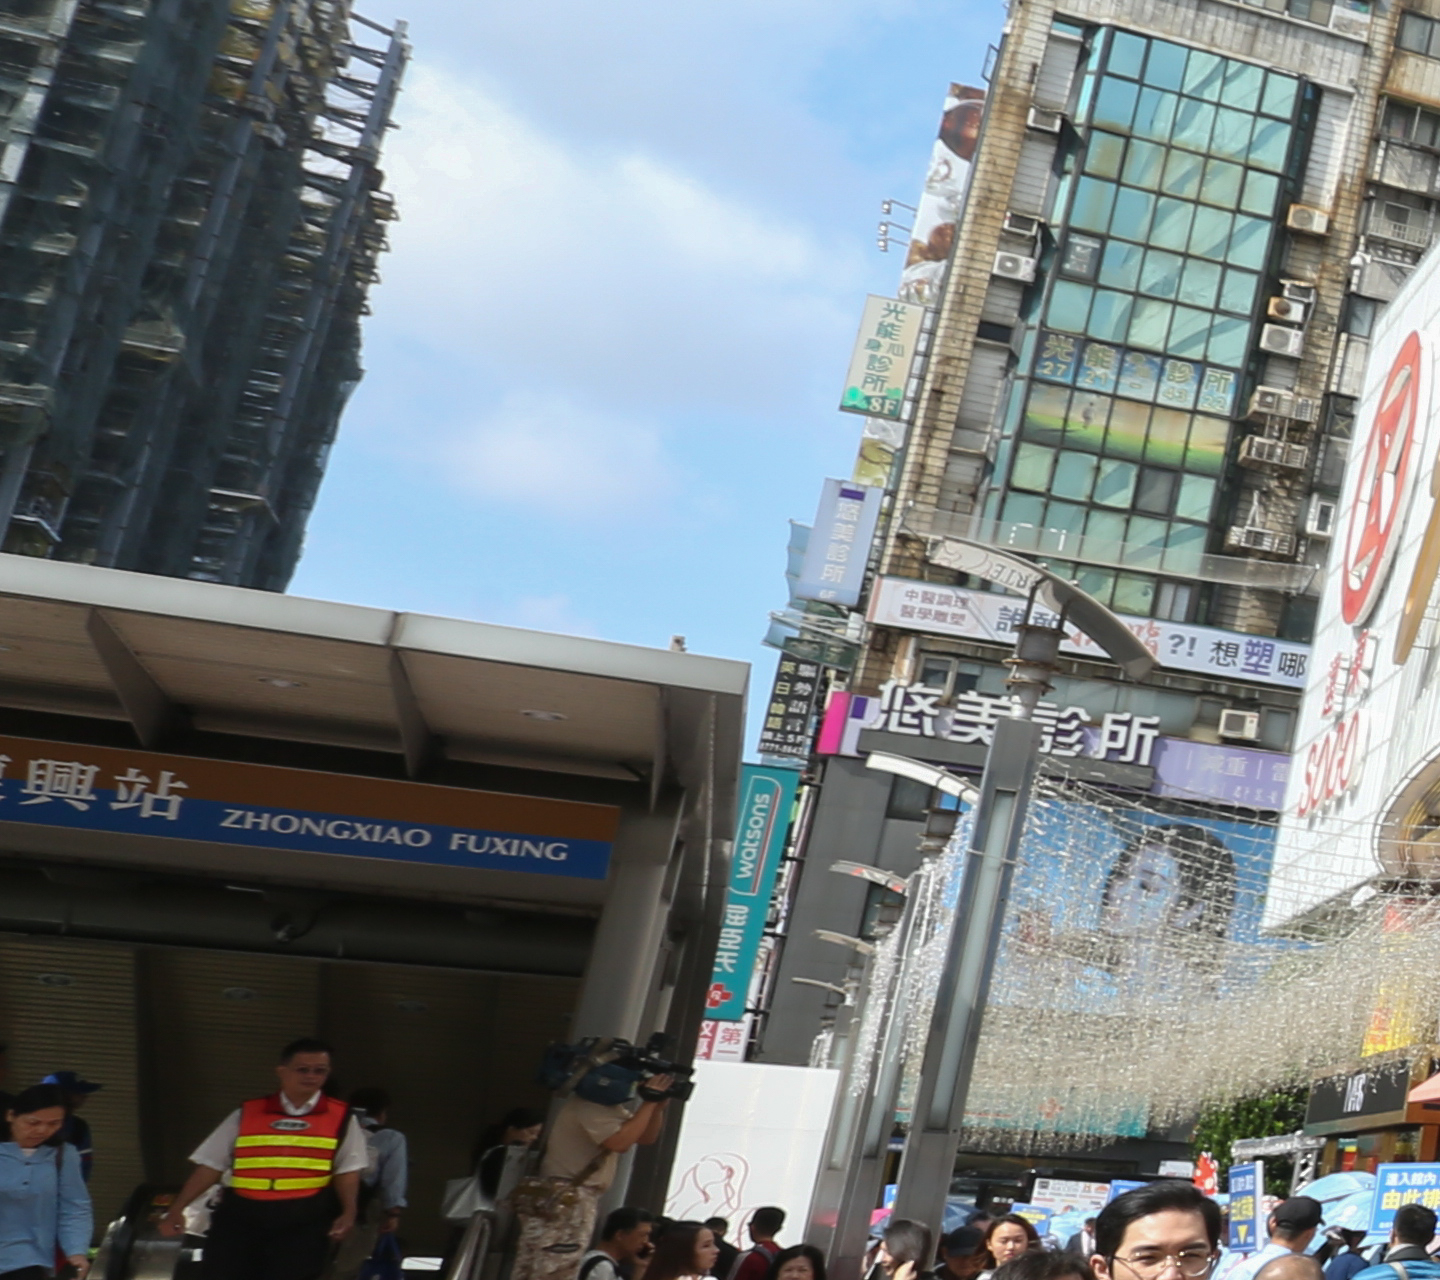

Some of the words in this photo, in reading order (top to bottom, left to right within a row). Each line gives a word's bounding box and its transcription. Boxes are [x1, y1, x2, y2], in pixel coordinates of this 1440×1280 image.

[868, 395, 896, 414] 8F
[869, 679, 1160, 767] 悠美診所
[0, 754, 190, 821] 興站
[1298, 710, 1359, 818] SOGO
[220, 808, 432, 848] ZHONGXIAO
[449, 832, 570, 862] FUXING
[735, 792, 771, 880] watsons
